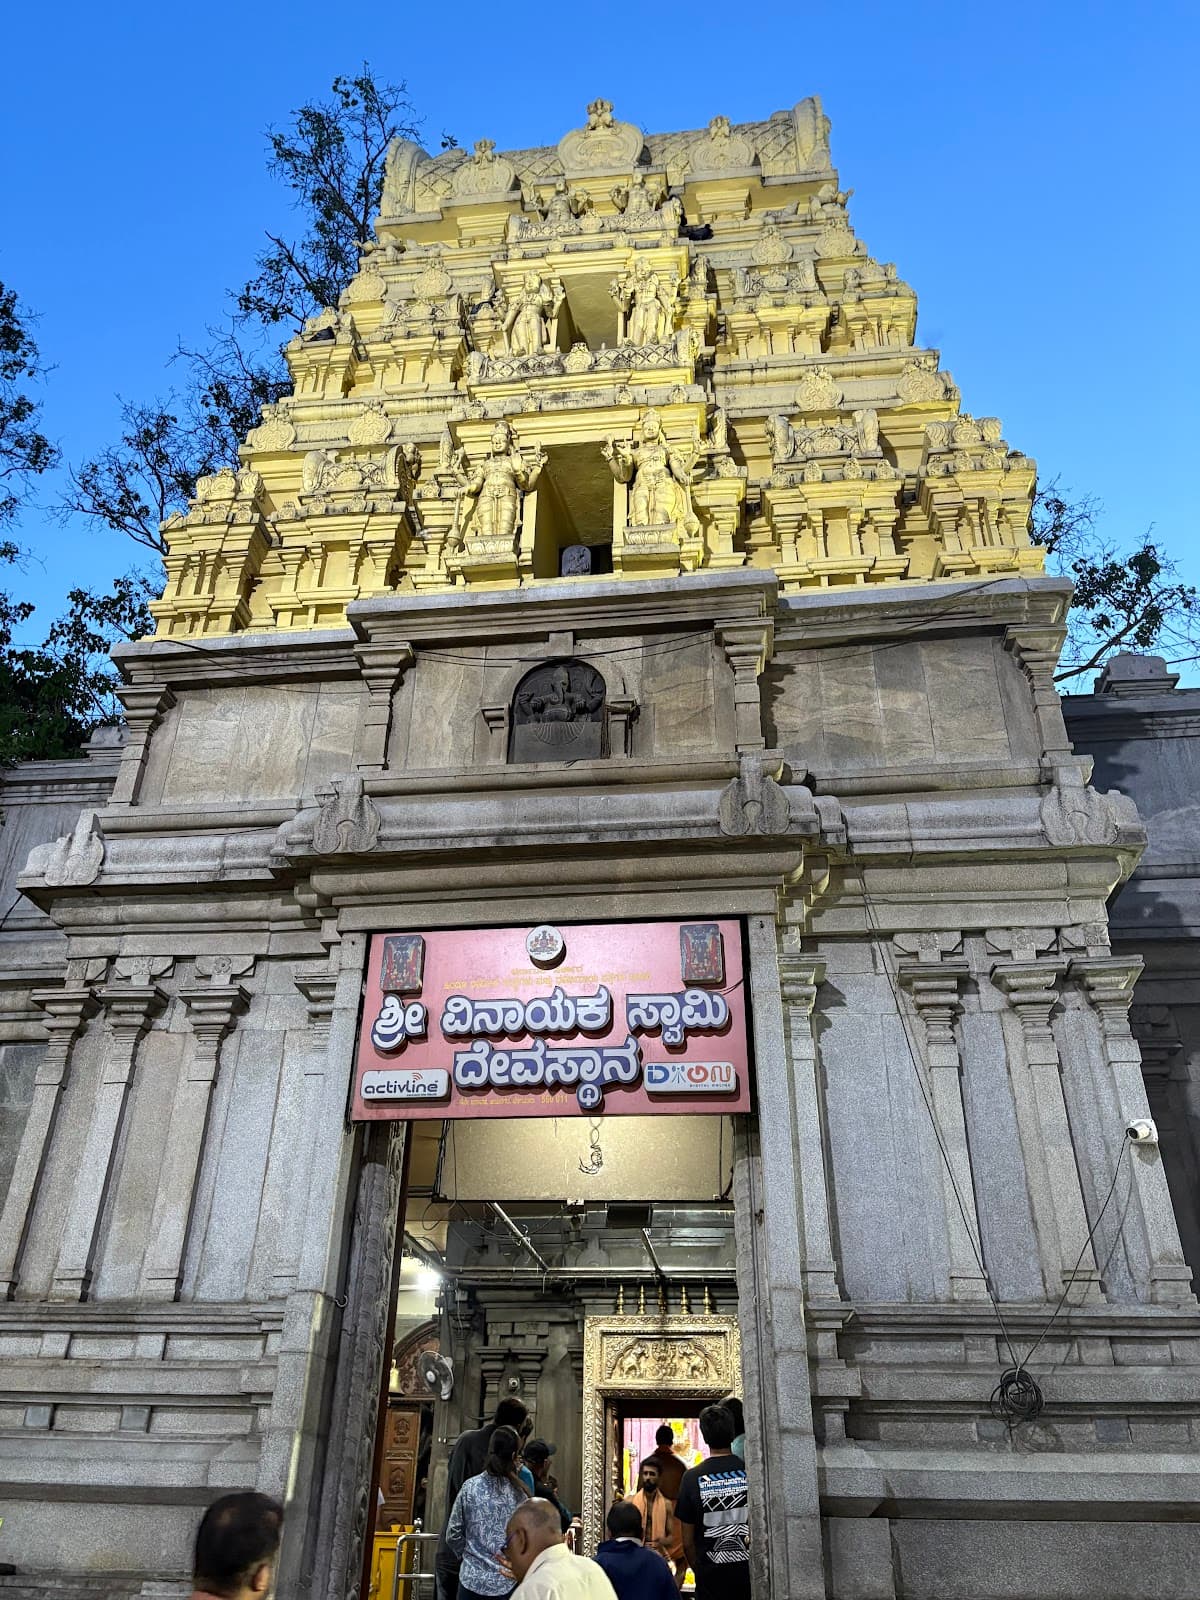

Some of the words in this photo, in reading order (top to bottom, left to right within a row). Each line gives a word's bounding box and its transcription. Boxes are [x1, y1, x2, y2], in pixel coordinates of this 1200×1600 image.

[372, 993, 427, 1049] ಶ್ರೀ
[441, 985, 611, 1034] ವಿನಾಯಕ
[627, 988, 730, 1044] ಸ್ವಾಮಿ
[364, 1080, 438, 1094] activline
[454, 1036, 640, 1108] ದೇವಸ್ಥಾನ
